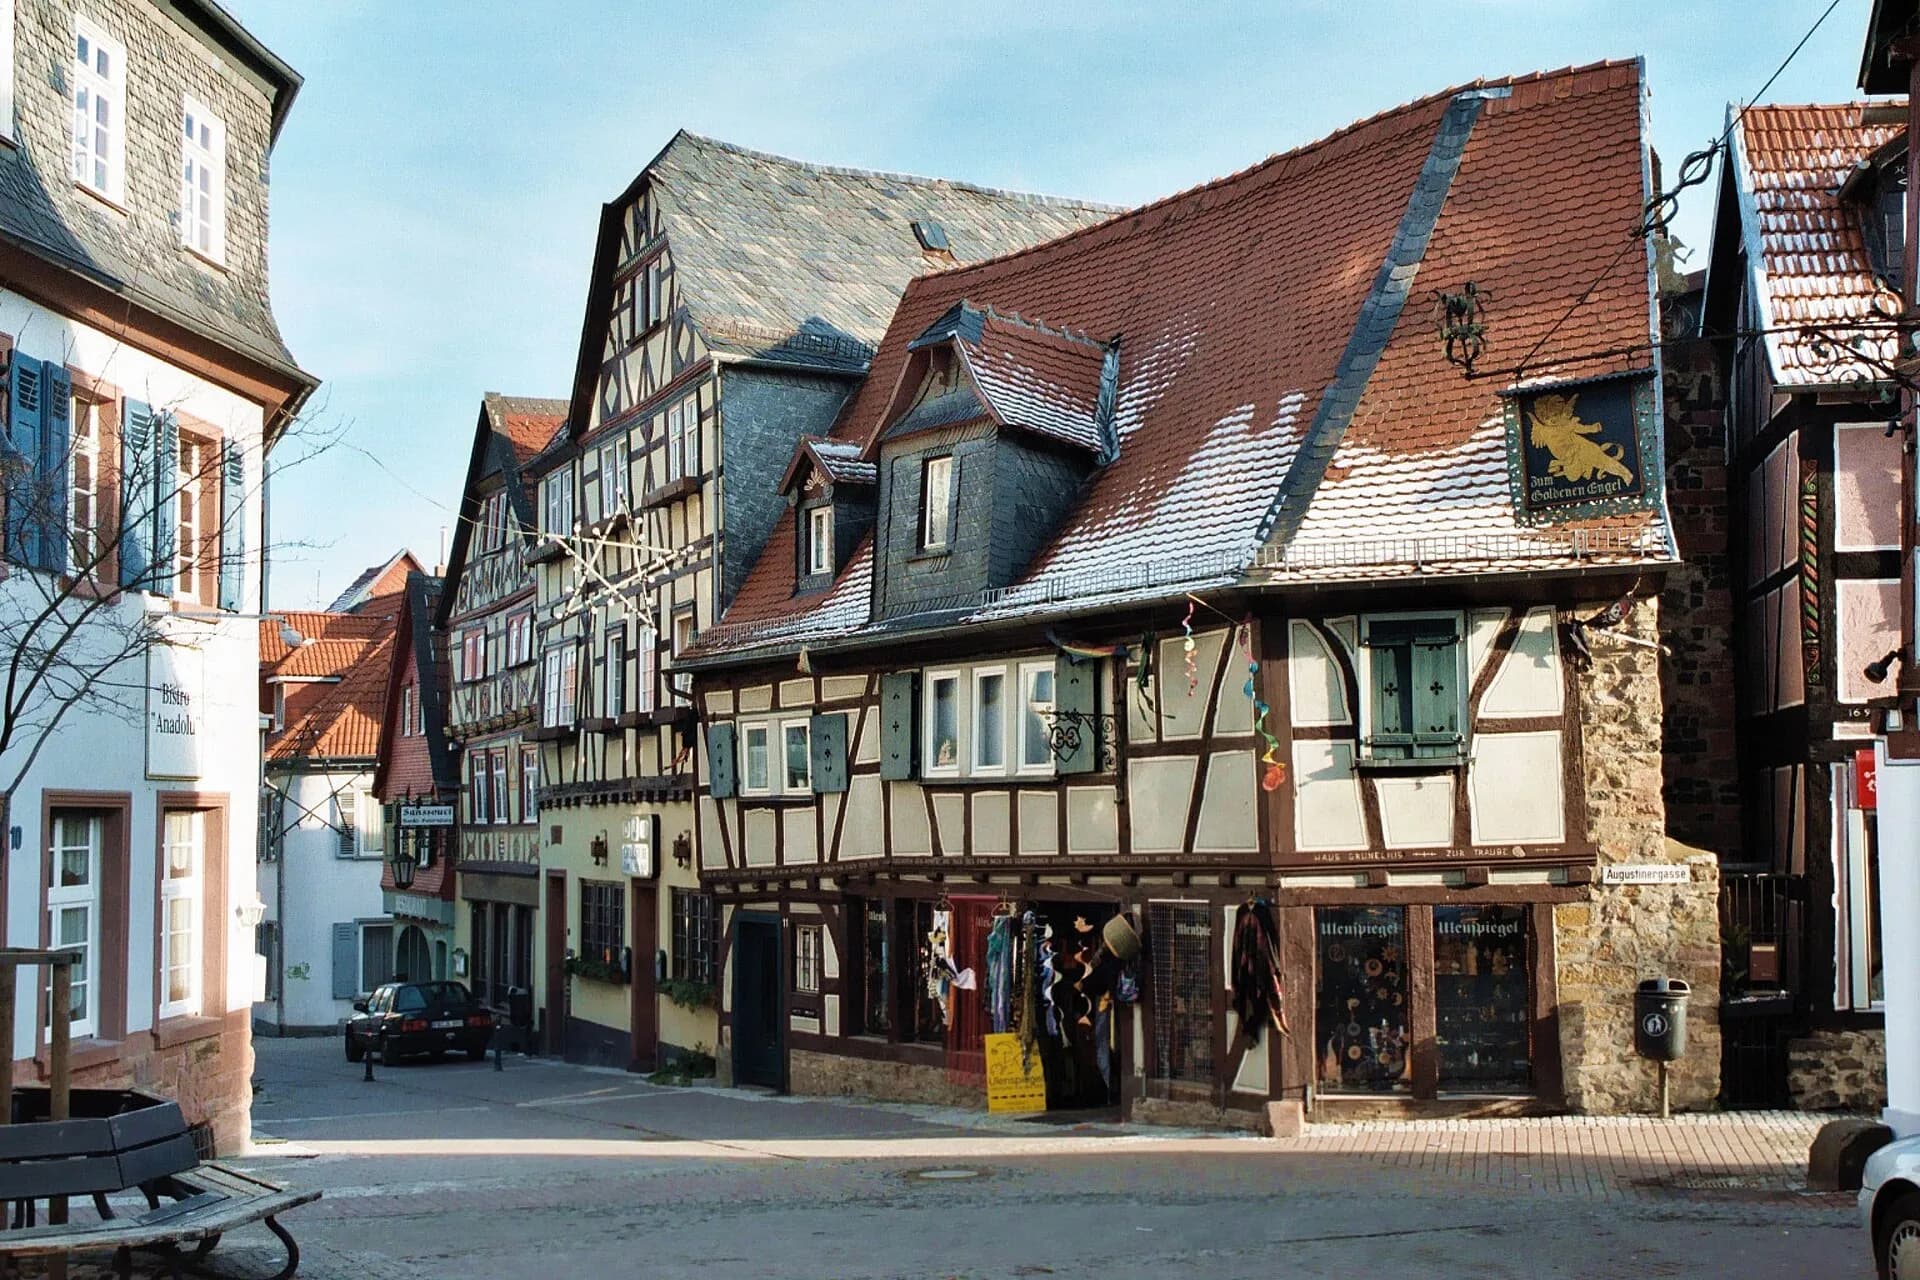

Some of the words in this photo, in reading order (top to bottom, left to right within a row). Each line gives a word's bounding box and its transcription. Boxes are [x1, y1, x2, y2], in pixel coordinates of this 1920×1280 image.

[1530, 476, 1553, 488] Zum
[1530, 486, 1585, 502] Goldenen
[1587, 479, 1621, 495] Engel
[161, 683, 190, 706] Bistro
[10, 825, 22, 851] 10
[1314, 853, 1340, 862] HAUS
[1445, 849, 1464, 857] ZUR
[1473, 848, 1508, 856] TRAUBE
[1606, 869, 1686, 882] Augustinergasse
